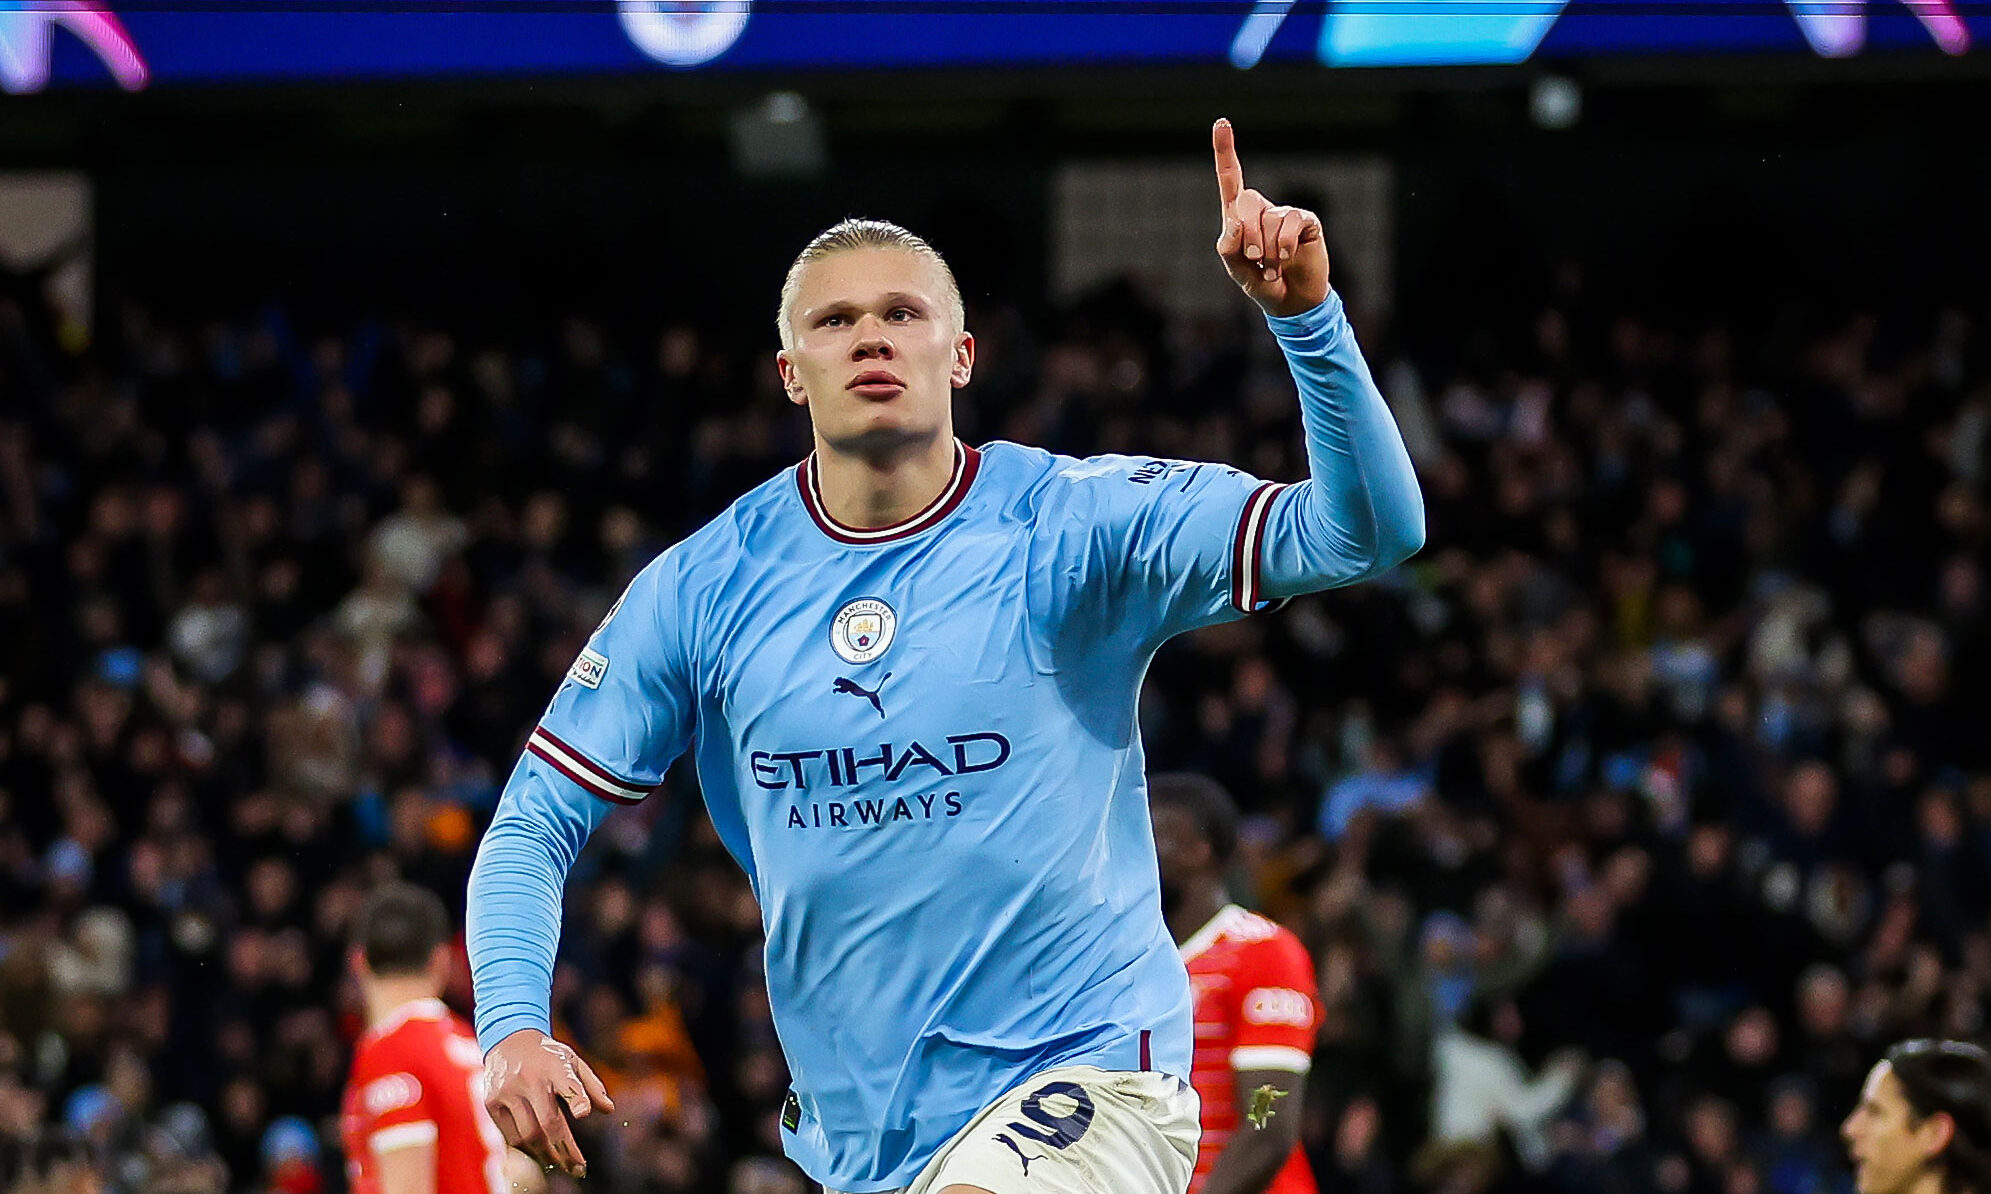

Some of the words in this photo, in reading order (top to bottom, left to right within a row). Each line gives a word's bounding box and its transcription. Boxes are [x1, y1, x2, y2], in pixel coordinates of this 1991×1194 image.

[838, 602, 892, 624] MANCHESTER
[853, 652, 873, 660] CITY
[750, 732, 1011, 790] ETIHAD
[787, 791, 962, 829] AIRWAYS
[1006, 1081, 1095, 1150] 9
